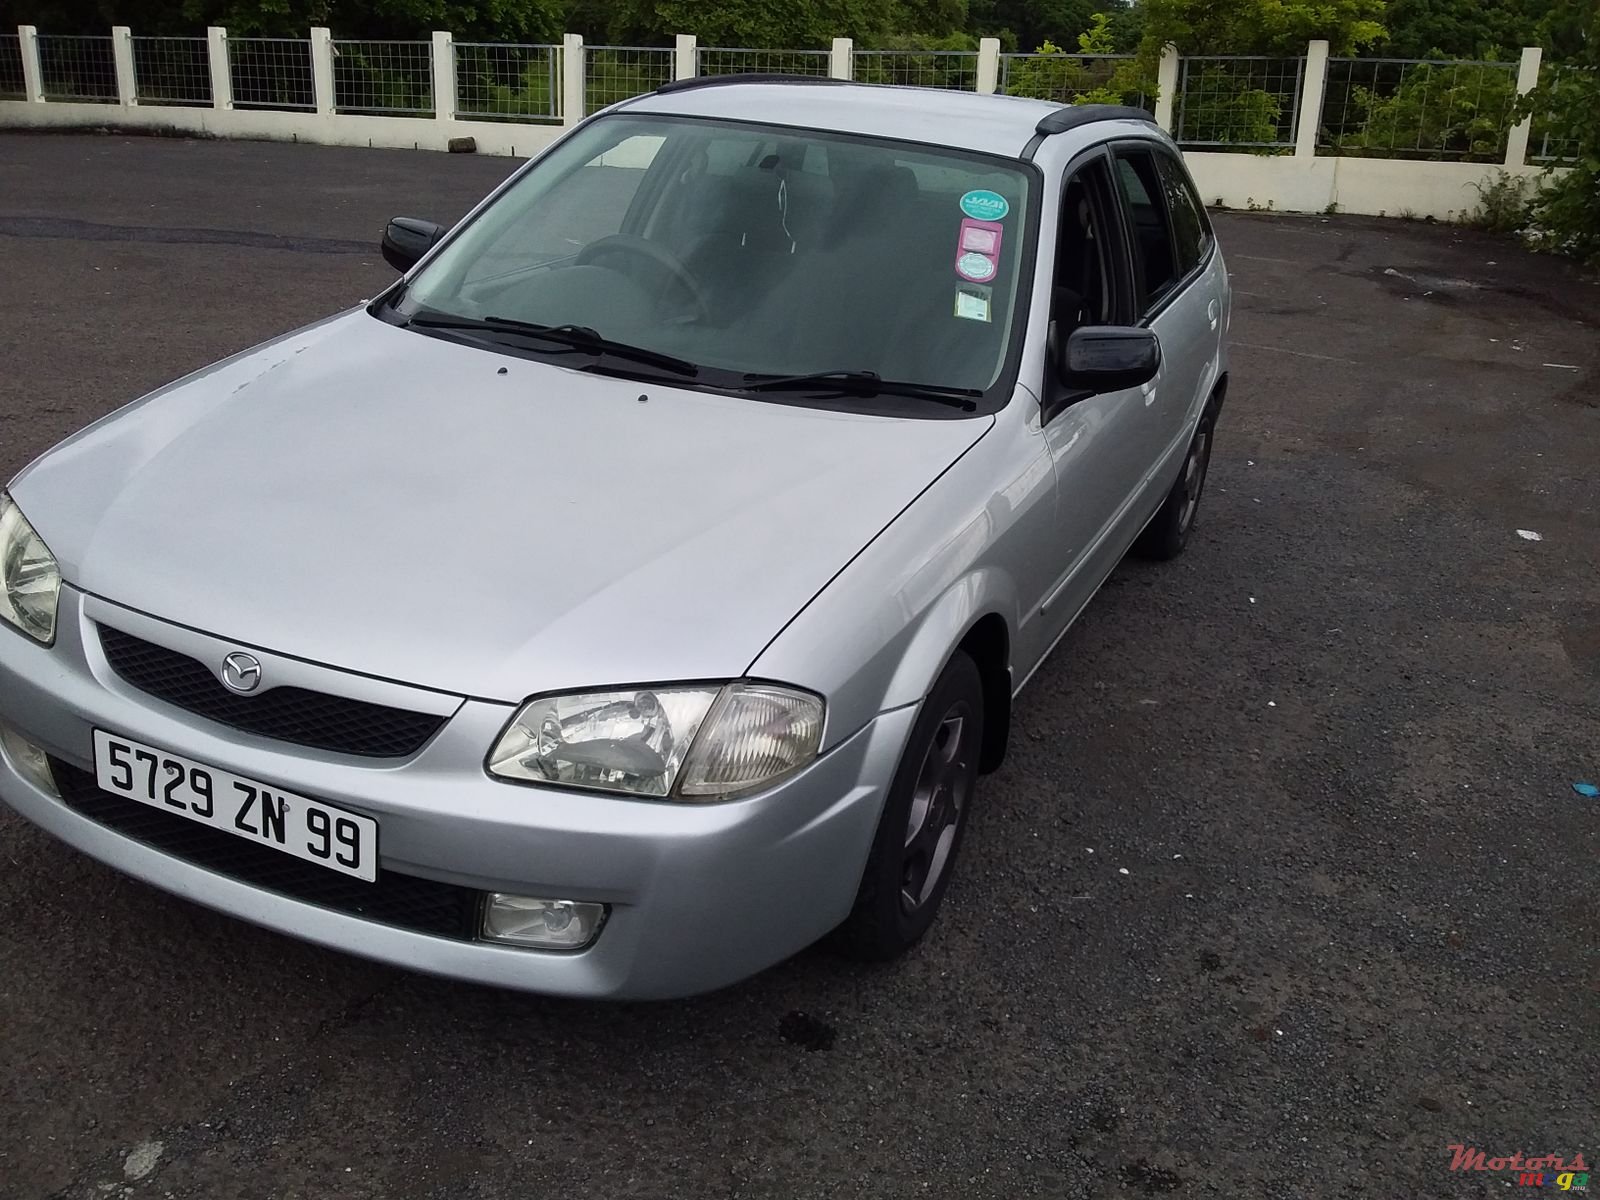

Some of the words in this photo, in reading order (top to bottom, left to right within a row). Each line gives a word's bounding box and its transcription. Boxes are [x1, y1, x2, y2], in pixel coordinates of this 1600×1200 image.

[109, 741, 213, 818] 5729
[233, 781, 286, 844] ZN
[307, 808, 360, 869] 99
